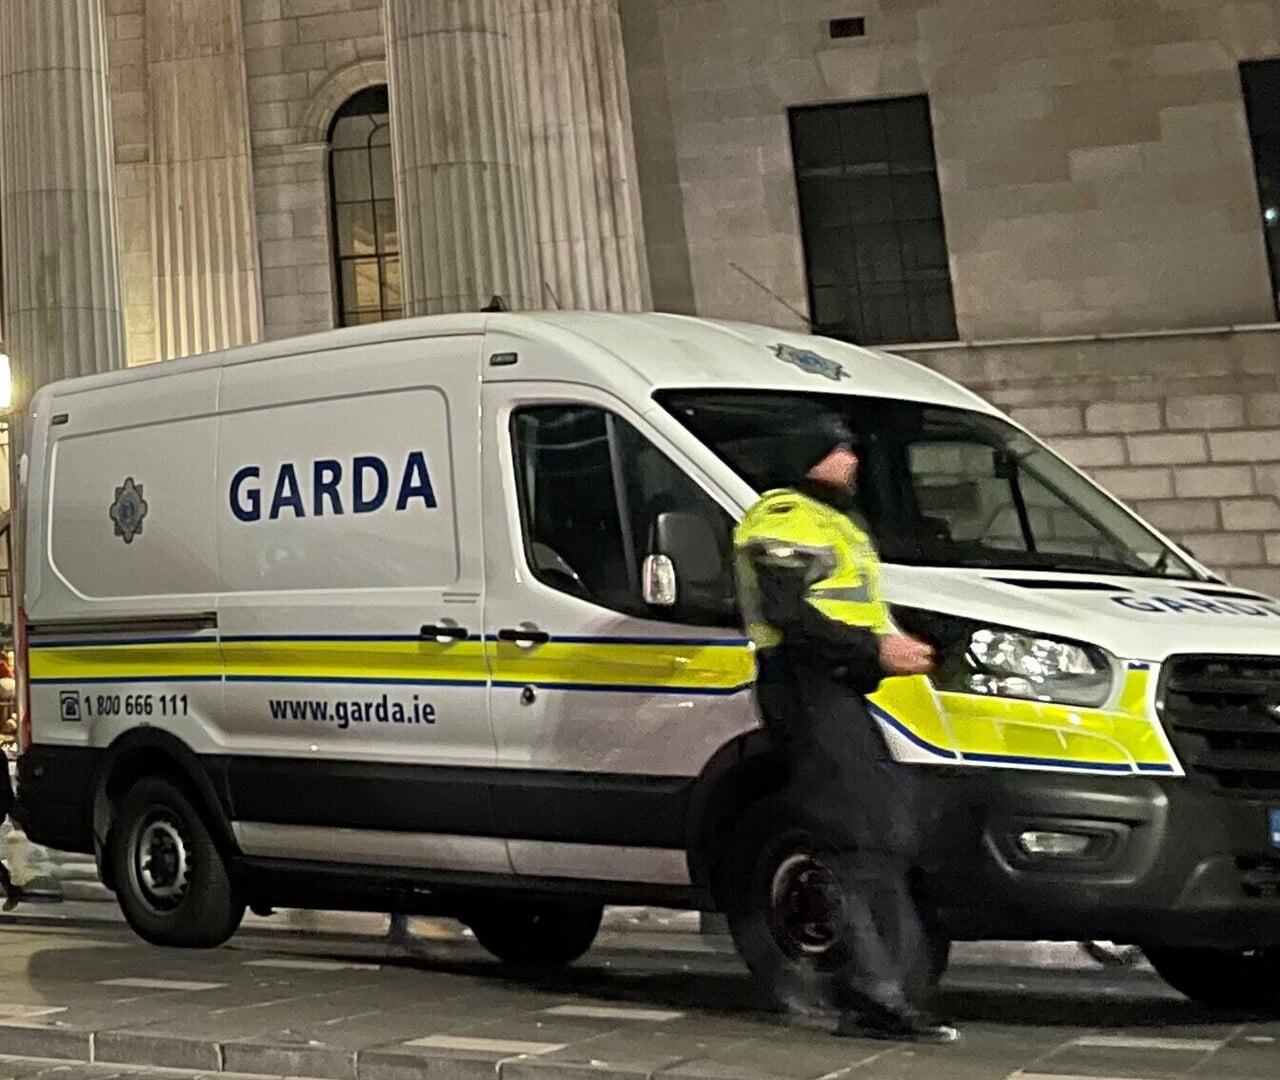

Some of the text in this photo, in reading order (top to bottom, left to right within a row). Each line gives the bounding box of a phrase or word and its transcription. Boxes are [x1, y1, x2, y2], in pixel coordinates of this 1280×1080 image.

[229, 451, 438, 522] GARDA
[84, 694, 188, 716] 1 800 666 111
[269, 693, 437, 729] www.garda.ie
